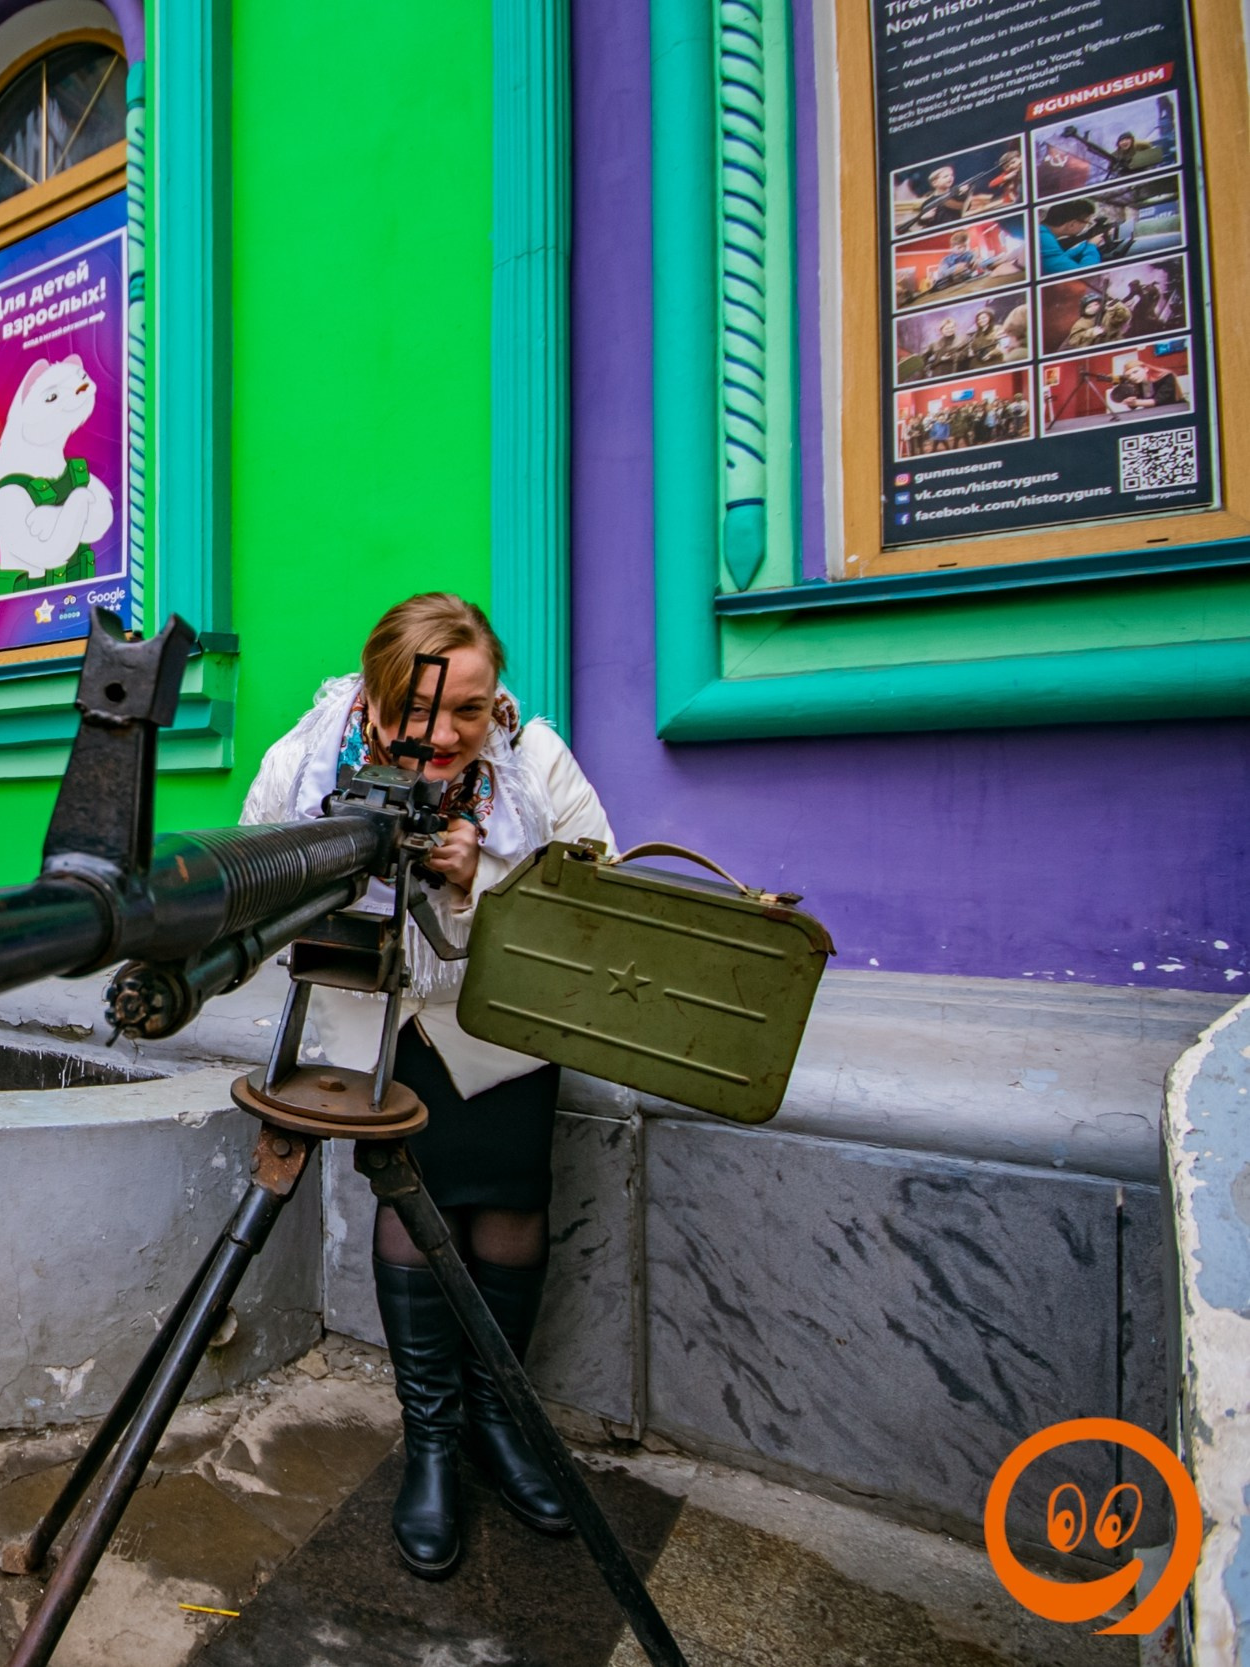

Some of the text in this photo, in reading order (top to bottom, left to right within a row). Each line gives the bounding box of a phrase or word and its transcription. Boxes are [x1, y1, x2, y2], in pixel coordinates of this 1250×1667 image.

[886, 13, 929, 36] Now
[902, 0, 1036, 49] Take and try real legendary
[902, 55, 931, 69] Make
[933, 42, 969, 62] unique
[970, 34, 996, 46] fotos
[998, 29, 1008, 38] in
[1010, 15, 1049, 34] historic
[888, 23, 1165, 114] Want more? We will take you to Young fighter course,
[903, 75, 930, 89] Want
[931, 72, 942, 80] to
[943, 63, 966, 77] look
[968, 53, 999, 68] inside
[1010, 39, 1035, 56] gun?
[1037, 33, 1061, 47] Easy
[1064, 28, 1076, 37] as
[1077, 18, 1104, 32] that!
[888, 59, 1084, 124] teach basics of weapon manipulations,
[888, 75, 1060, 134] tactical medicine and many more!
[1032, 67, 1165, 116] #GUNMUSEUM
[30, 259, 89, 307] детей
[2, 276, 106, 340] взрослых!
[914, 459, 1003, 484] gunmuseum
[914, 471, 1060, 502] vk.com/historyguns
[915, 485, 1113, 523] facebook.com/historyguns
[87, 587, 126, 604] Google
